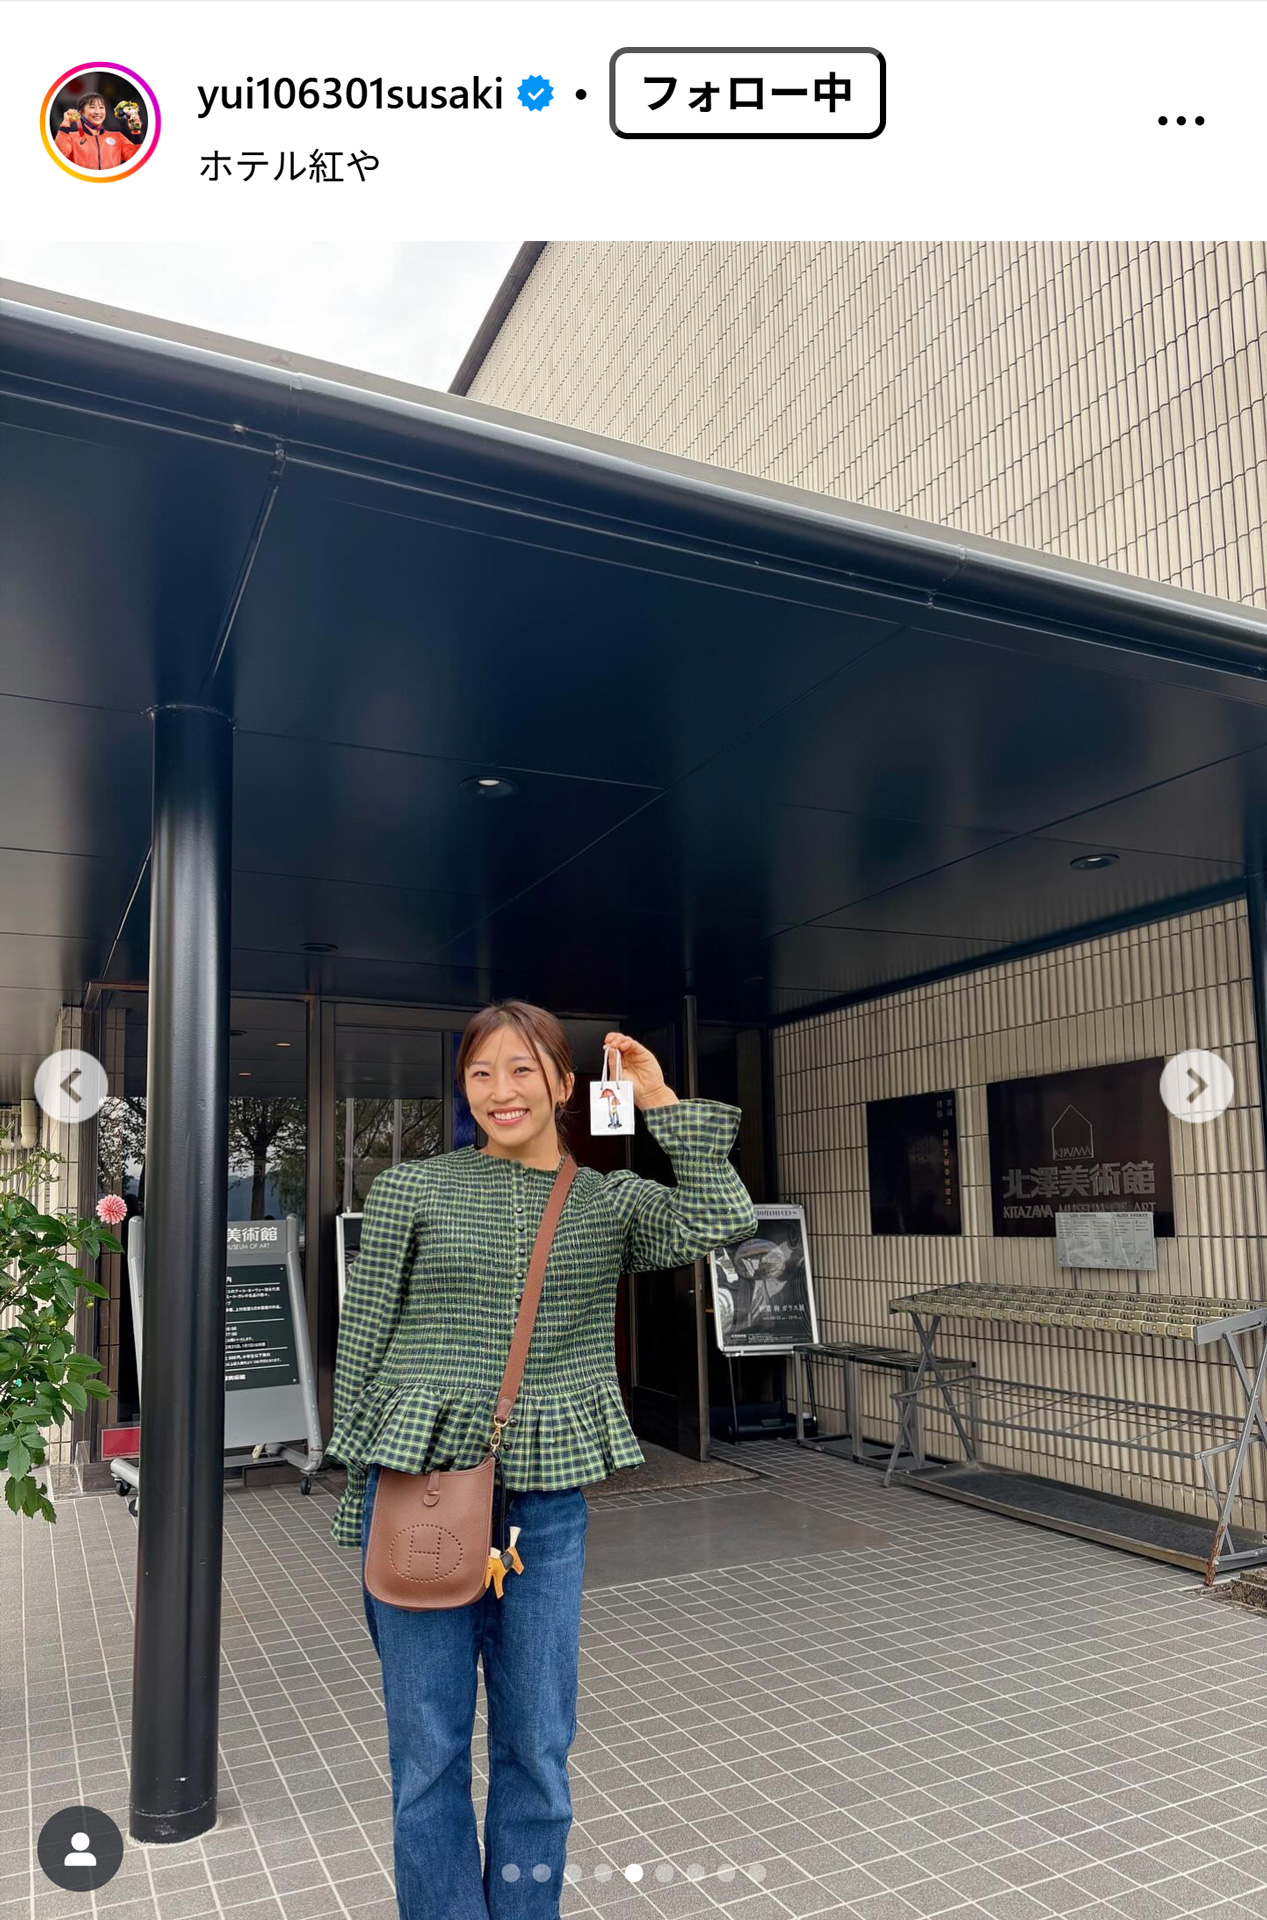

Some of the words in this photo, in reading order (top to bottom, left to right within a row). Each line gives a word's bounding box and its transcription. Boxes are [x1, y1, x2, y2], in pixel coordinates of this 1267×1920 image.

[1002, 1160, 1155, 1200] 北澤美術館
[1003, 1204, 1053, 1219] KITAZAWA
[227, 1226, 278, 1243] 美術館
